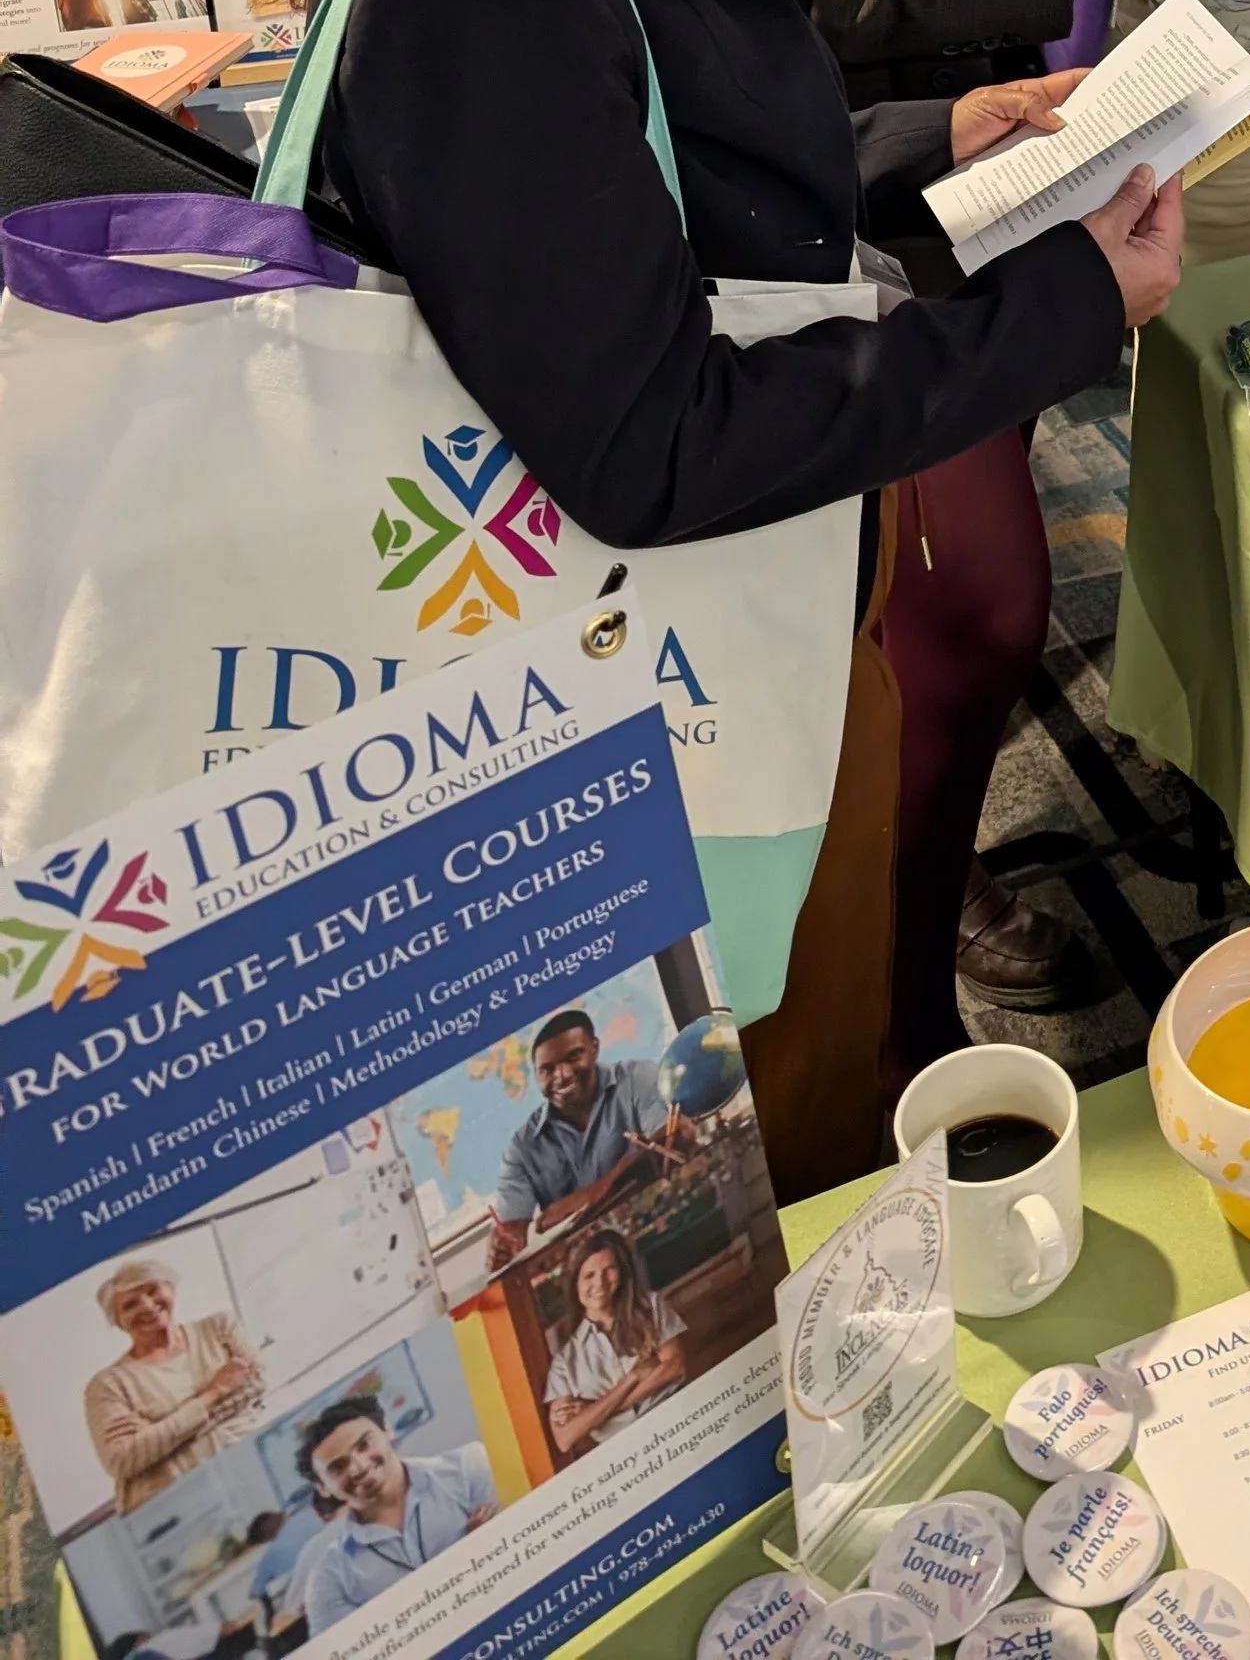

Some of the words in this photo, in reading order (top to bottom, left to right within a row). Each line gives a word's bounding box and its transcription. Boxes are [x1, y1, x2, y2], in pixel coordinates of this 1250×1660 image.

[178, 666, 572, 888] IDIOMA
[195, 820, 383, 919] EDUCATION
[380, 809, 400, 830] &
[406, 720, 590, 816] CONSULTING
[443, 759, 651, 883] COURSES
[52, 1092, 128, 1143] FOR
[131, 1019, 267, 1097] WORLD
[276, 922, 449, 1026] LANGUAGE
[454, 840, 604, 930] TEACHERS
[25, 1156, 128, 1222] Spanish
[147, 1097, 237, 1157] French
[256, 1051, 332, 1099] Italian
[350, 1008, 411, 1048] Latin
[429, 950, 519, 1004] German
[535, 880, 648, 949] Portuguese
[81, 1156, 207, 1232] Mandarin
[213, 1099, 310, 1158] Chinese
[330, 1004, 482, 1097] Methodology
[489, 989, 508, 1009] &
[514, 931, 615, 996] Pedagogy
[1135, 1332, 1249, 1393] IDIOMA
[1208, 1361, 1238, 1378] FIND
[1034, 1377, 1109, 1462] português!
[1037, 1391, 1072, 1423] Falo
[1066, 1425, 1108, 1458] IDIOMA
[1144, 1414, 1184, 1438] FRIDAY
[395, 1537, 520, 1629] graduate-level
[512, 1501, 568, 1544] courses
[571, 1483, 594, 1504] for
[597, 1452, 638, 1486] salary
[643, 1384, 749, 1455] advancement,
[617, 1504, 726, 1582] 978-494-6430
[914, 1522, 984, 1559] Latine
[1049, 1541, 1072, 1564] Je
[1068, 1487, 1107, 1541] parle
[1067, 1492, 1132, 1589] français!
[902, 1546, 982, 1594] loquor!
[1097, 1540, 1139, 1577] IDIOMA
[1155, 1588, 1178, 1615] Ich
